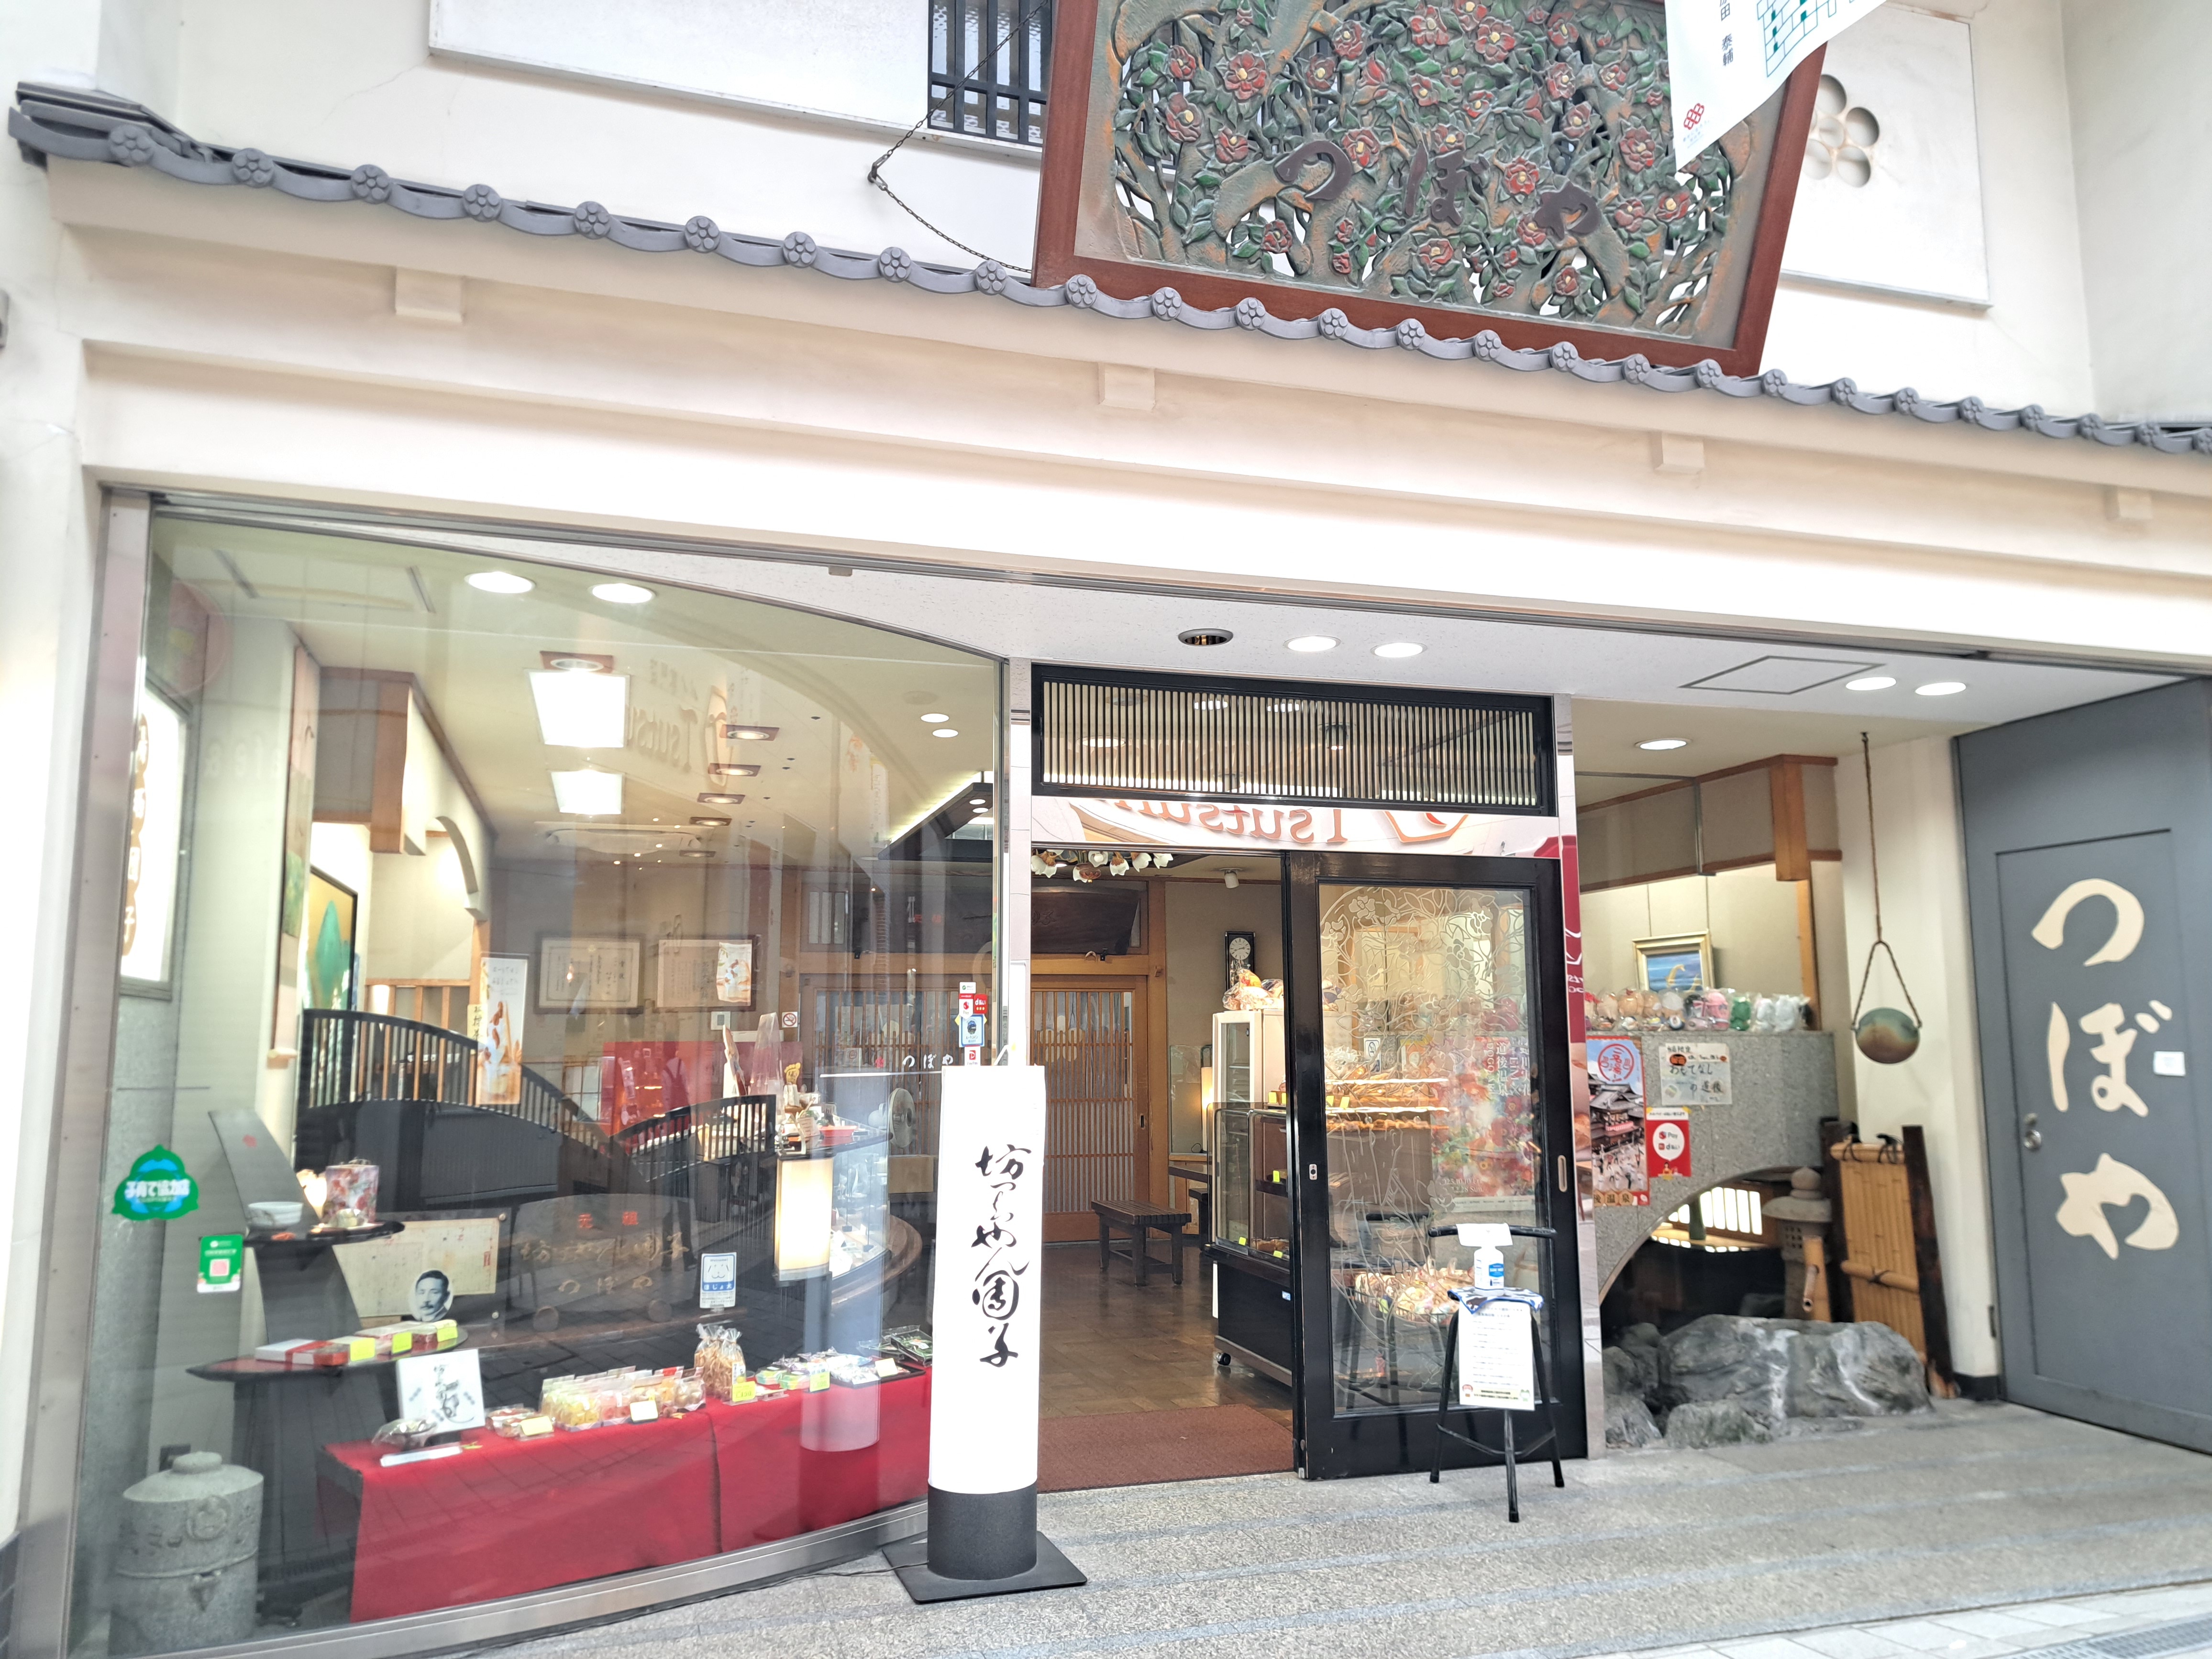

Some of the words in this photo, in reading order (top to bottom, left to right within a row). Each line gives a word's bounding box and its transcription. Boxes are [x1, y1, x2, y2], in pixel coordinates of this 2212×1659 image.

[1273, 140, 1602, 240] つぼや
[902, 1053, 953, 1069] つぼや
[2030, 878, 2179, 1261] つぼや
